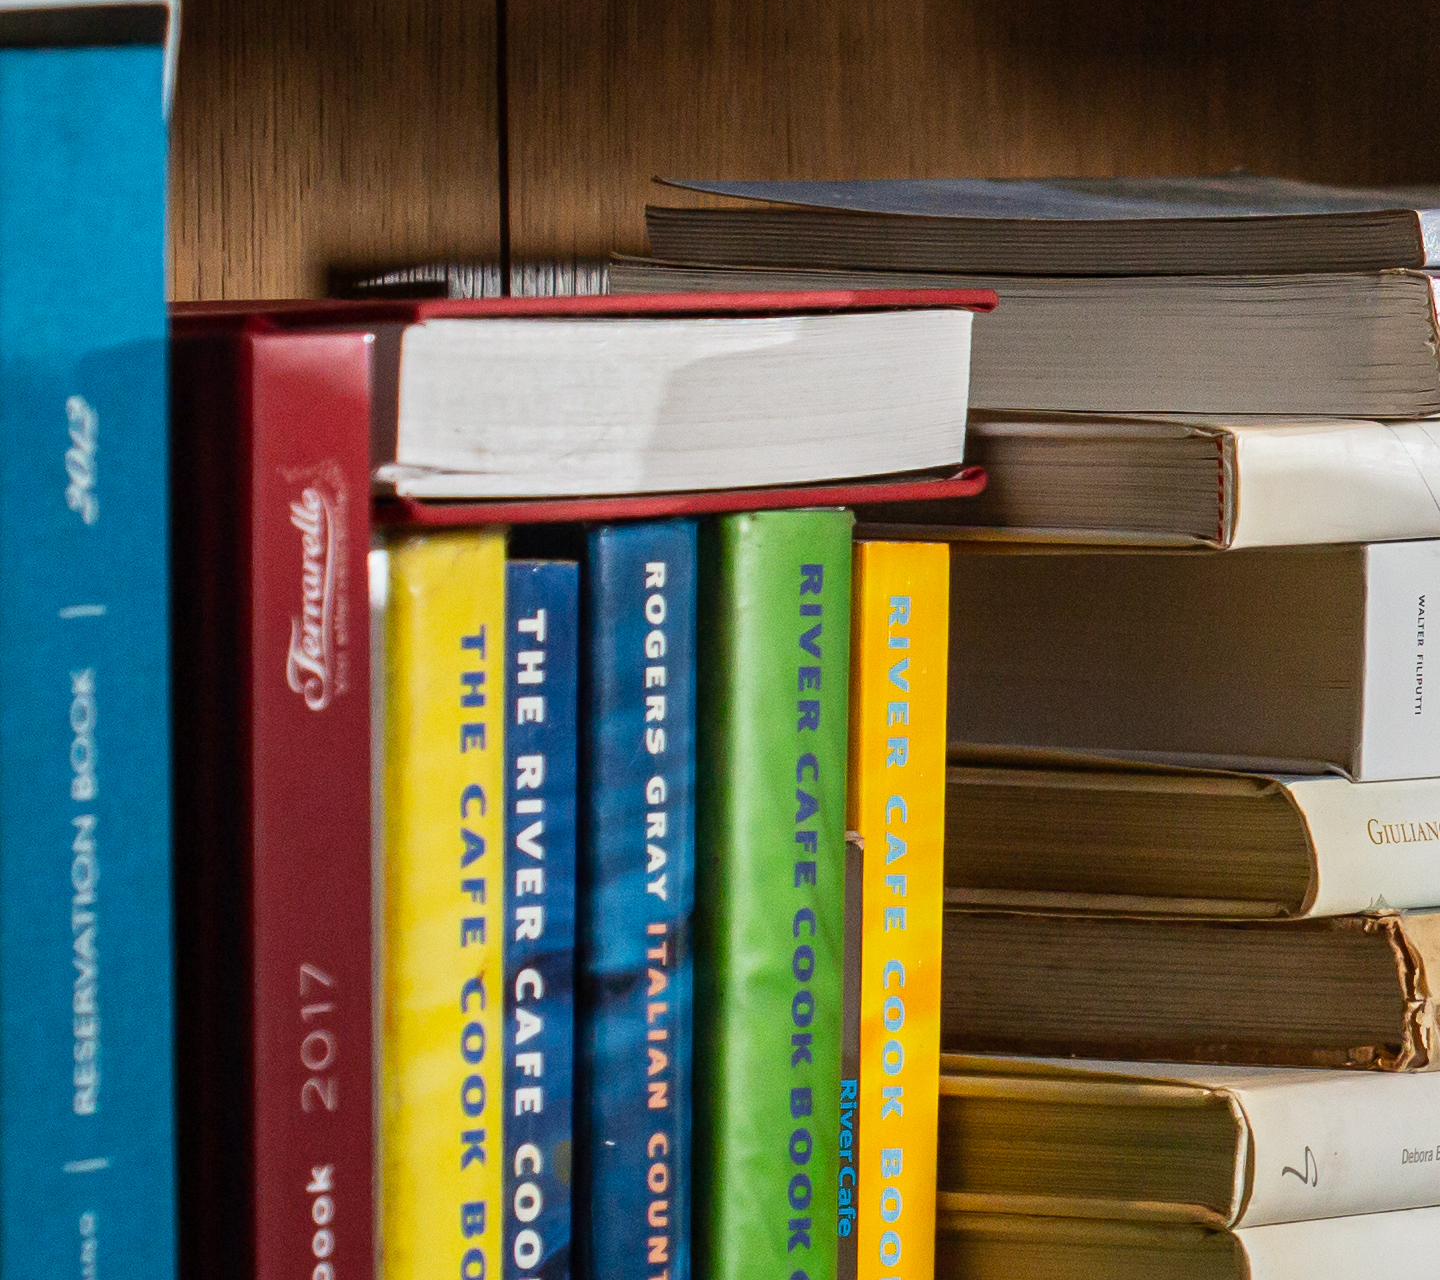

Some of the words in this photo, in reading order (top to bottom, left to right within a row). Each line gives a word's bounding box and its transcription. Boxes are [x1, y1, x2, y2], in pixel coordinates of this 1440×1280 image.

[458, 623, 487, 755] THE
[516, 607, 548, 724] THE
[645, 560, 668, 756] ROGERS
[796, 562, 825, 733] RIVER
[885, 594, 911, 770] RIVER
[1414, 653, 1425, 716] FILIPUTTI
[1416, 594, 1426, 647] WALTER
[70, 668, 97, 802] BOOK
[458, 781, 487, 948] CAFE
[514, 753, 547, 943] RIVER
[645, 775, 668, 904] GRAY
[792, 751, 820, 888] CAFE
[883, 793, 908, 933] CAFE
[72, 813, 100, 1116] RESERVATION
[300, 962, 338, 1113] 2017
[646, 922, 670, 1111] ITALIAN
[790, 906, 817, 1069] COOK
[880, 958, 905, 1122] COOK
[458, 975, 487, 1172] COOK
[515, 965, 547, 1117] CAFE
[786, 1085, 814, 1255] BOOK
[839, 1078, 858, 1163] River
[1400, 1145, 1433, 1166] Debora
[837, 1165, 856, 1238] Cafe
